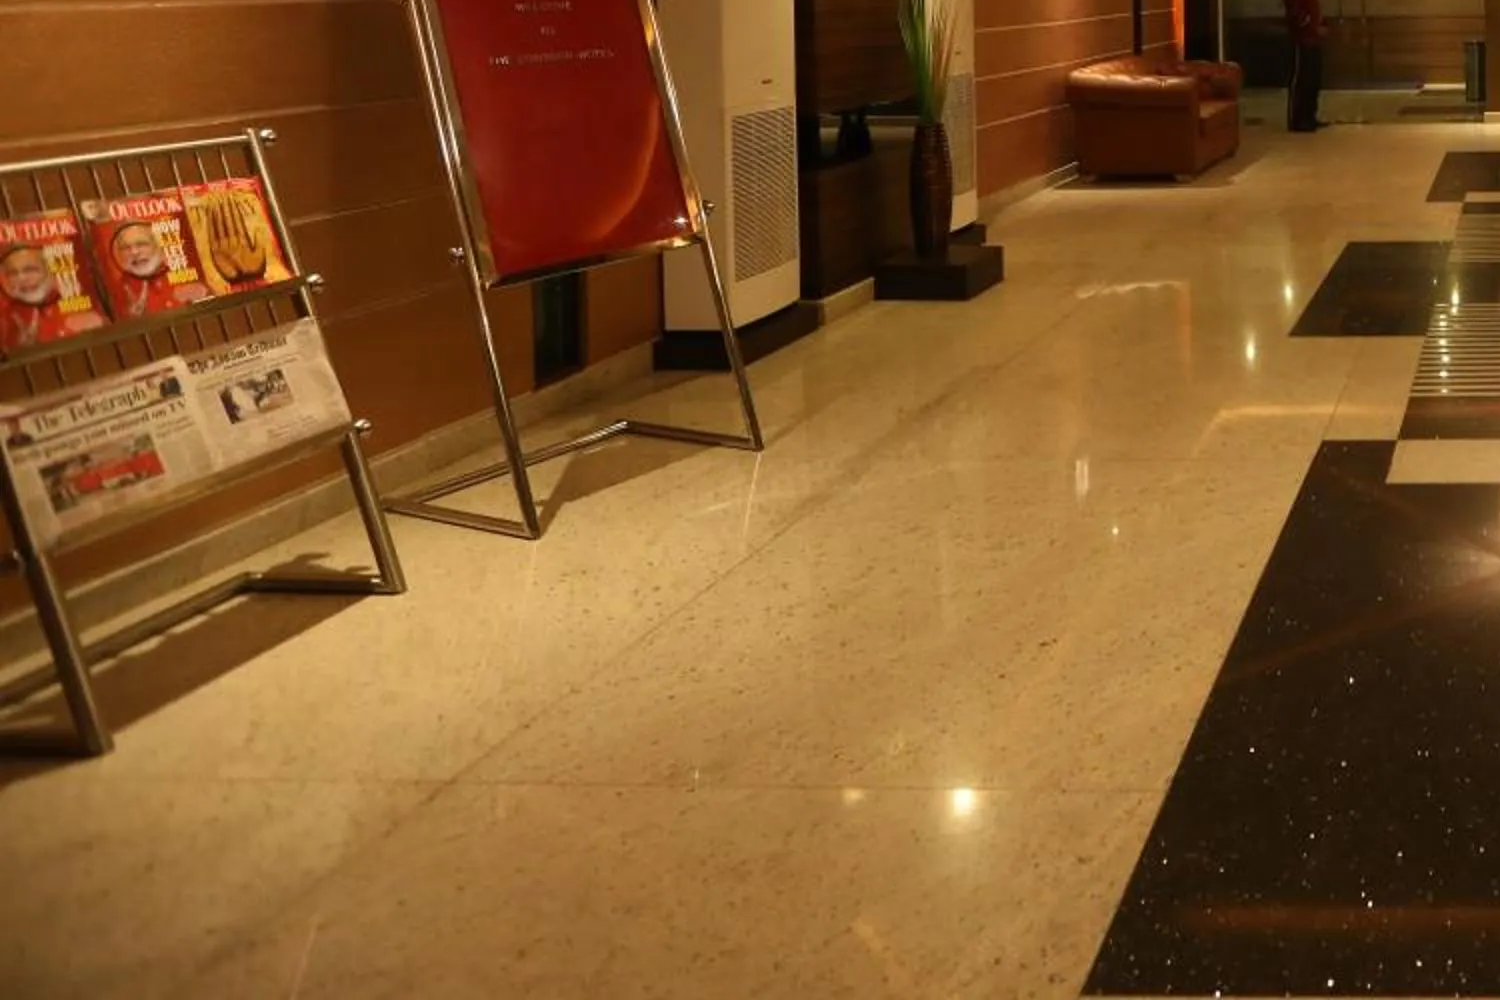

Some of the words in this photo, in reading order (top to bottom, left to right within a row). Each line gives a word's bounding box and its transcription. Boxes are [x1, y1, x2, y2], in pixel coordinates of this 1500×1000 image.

[108, 199, 183, 221] OUTLOOK
[33, 411, 65, 433] The
[68, 382, 148, 422] Telegraph
